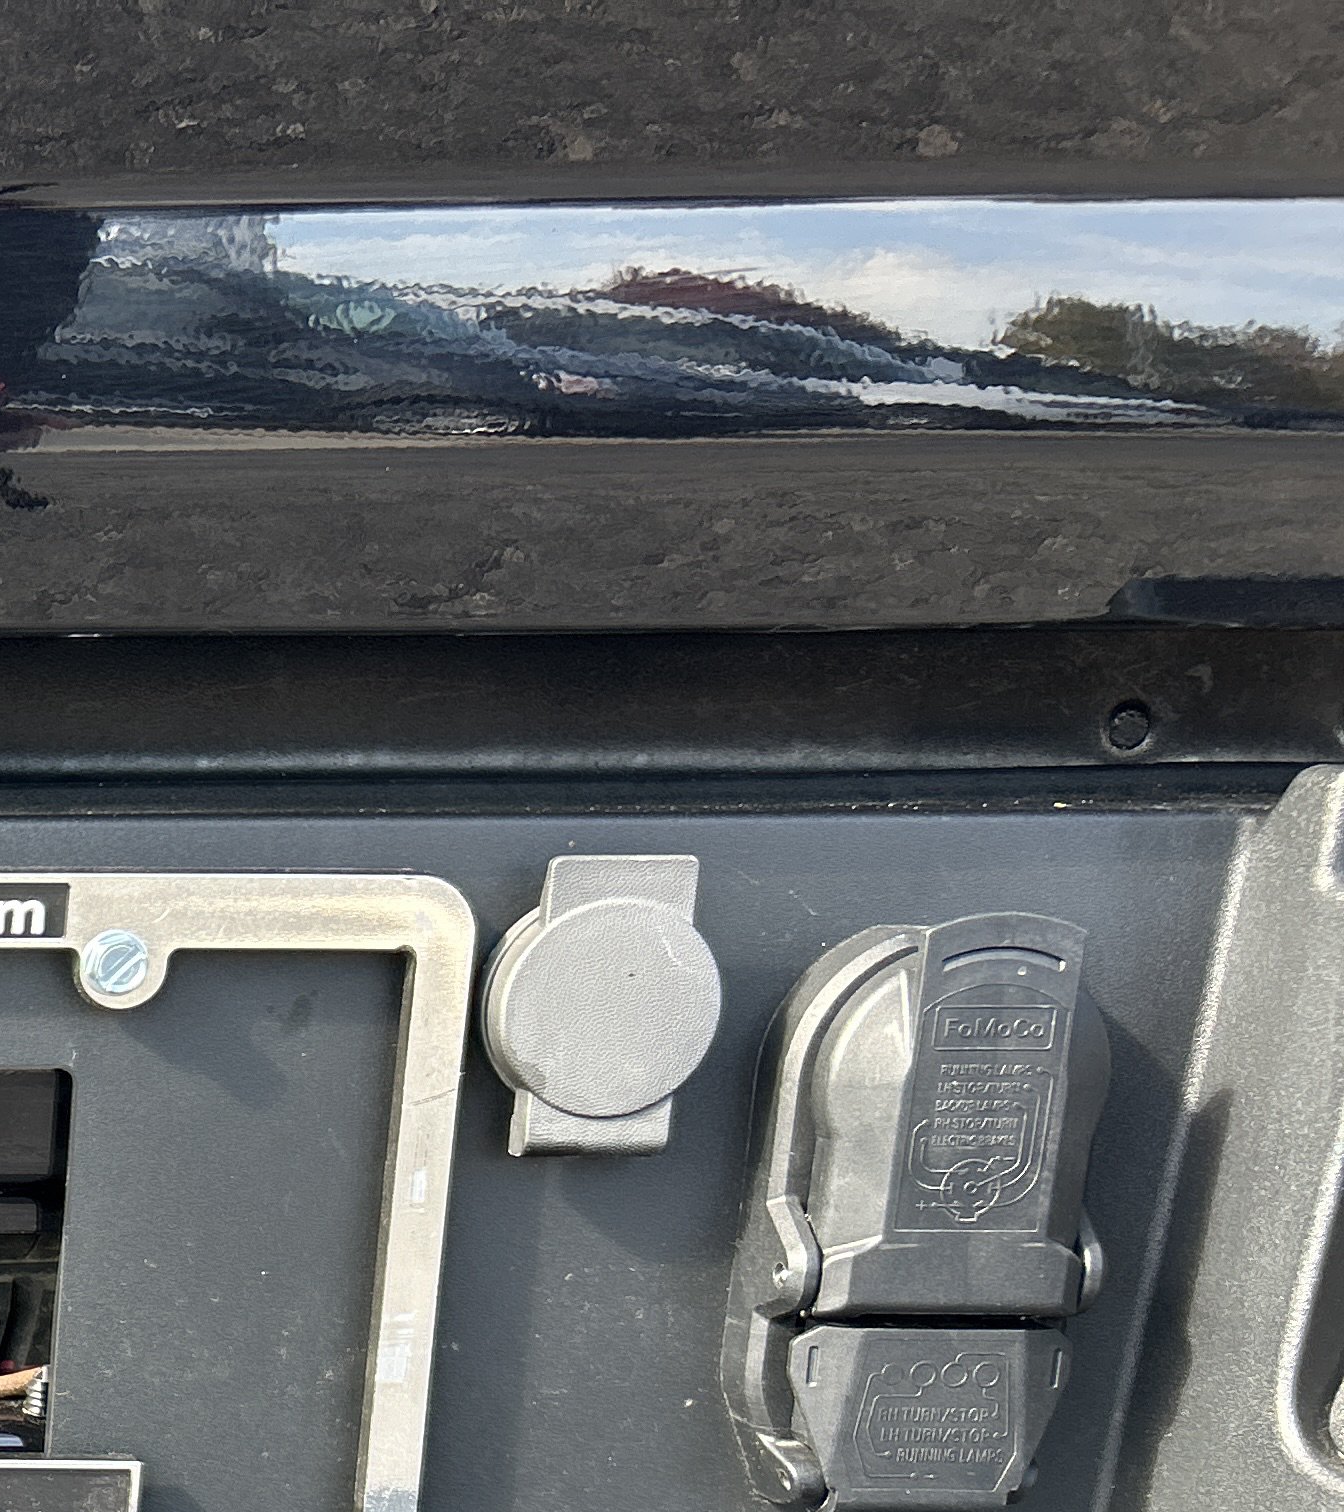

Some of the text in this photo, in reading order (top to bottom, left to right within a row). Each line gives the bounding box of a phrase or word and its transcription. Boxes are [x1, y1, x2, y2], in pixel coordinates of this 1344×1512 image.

[943, 1016, 1045, 1038] FoMoCo
[878, 1407, 989, 1422] RH TURN/STOP
[879, 1427, 991, 1443] LH TURN/STOP
[895, 1447, 1004, 1463] RUNNING LAMPS
